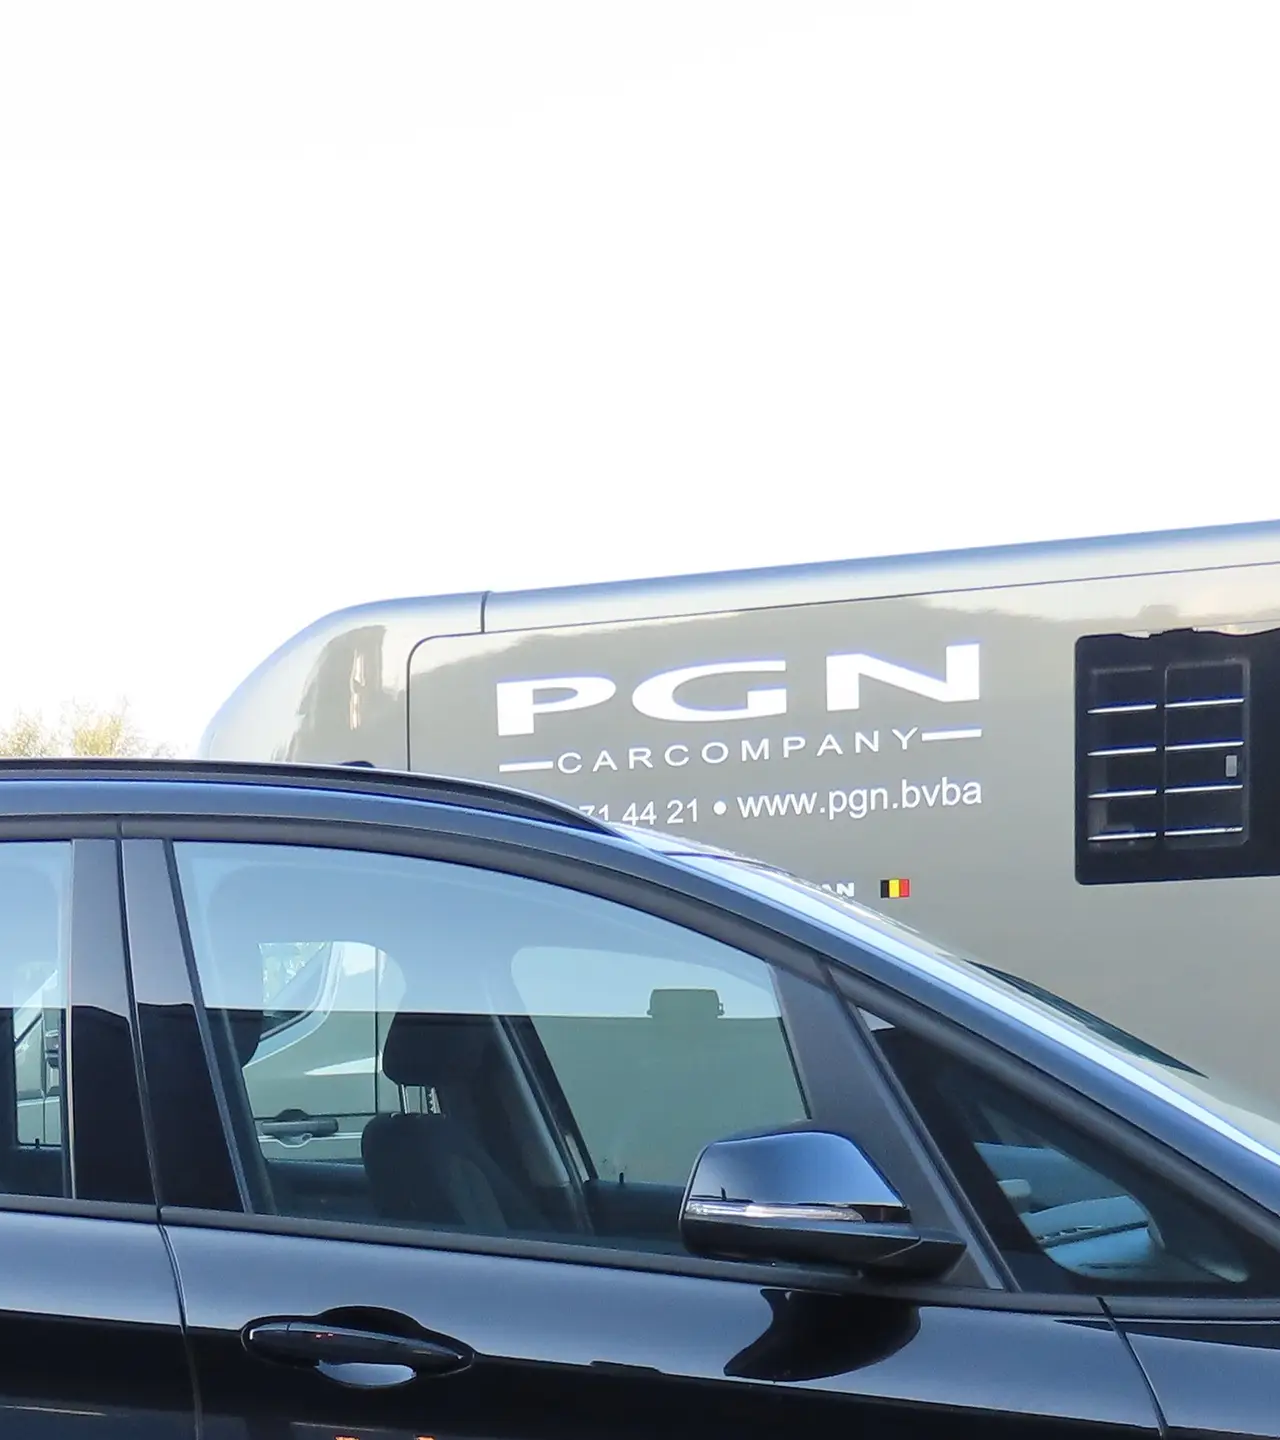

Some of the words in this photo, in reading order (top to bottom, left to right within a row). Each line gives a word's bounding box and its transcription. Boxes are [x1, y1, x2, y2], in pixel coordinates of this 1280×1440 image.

[496, 642, 981, 736] PGN
[556, 727, 919, 775] CARCOMPANY
[622, 801, 657, 826] 44
[667, 798, 698, 824] 21
[736, 776, 982, 820] www.pgn.bvba
